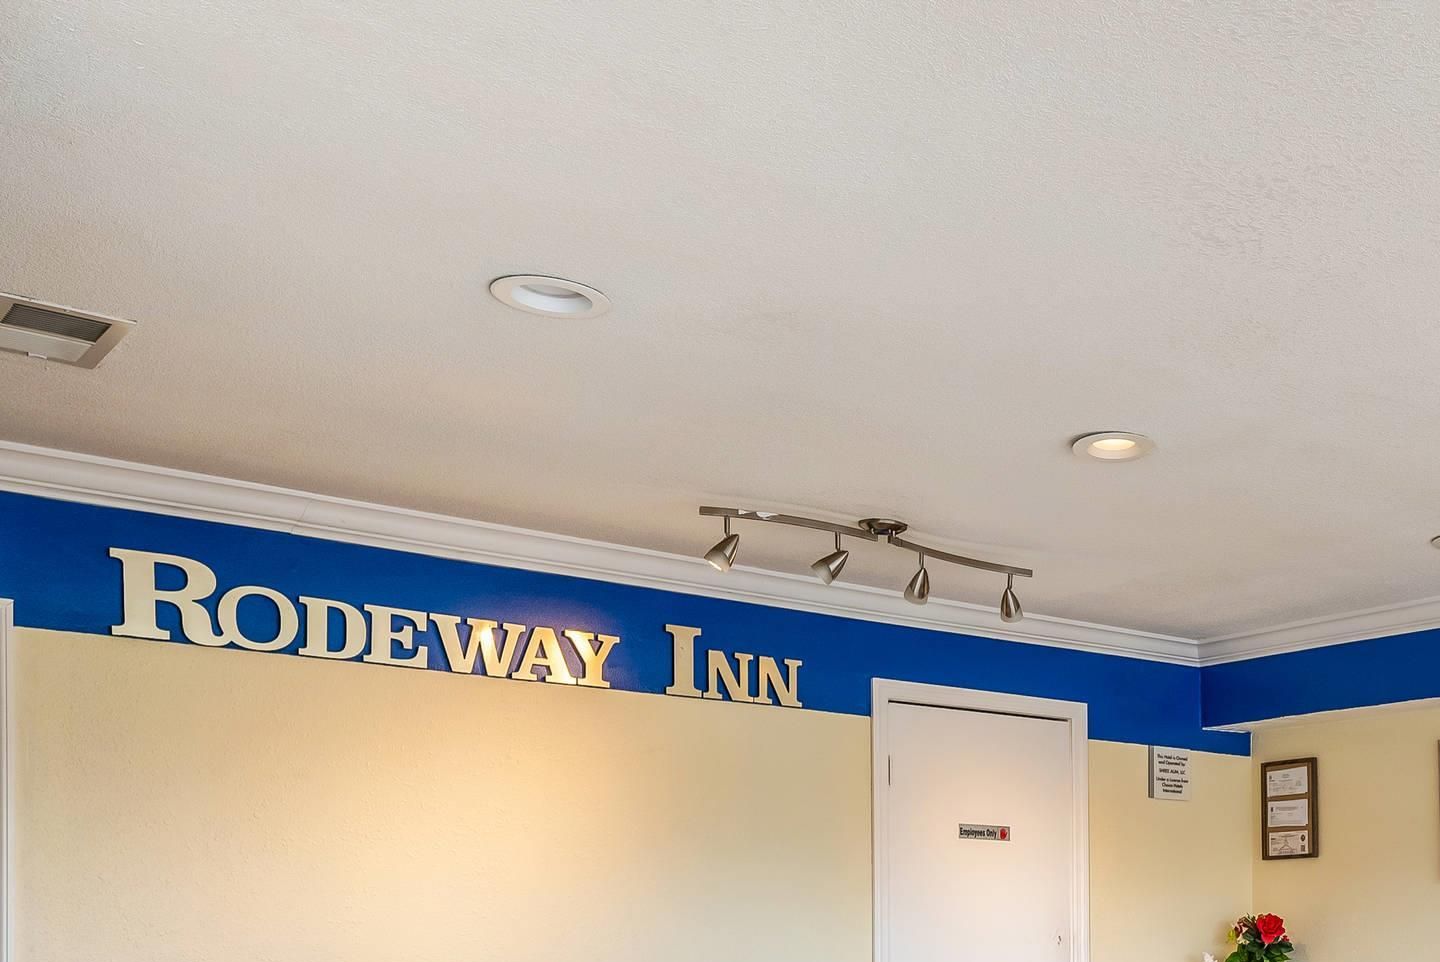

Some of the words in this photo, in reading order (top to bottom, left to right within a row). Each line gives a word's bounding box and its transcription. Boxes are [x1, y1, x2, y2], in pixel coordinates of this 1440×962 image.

[108, 546, 621, 691] RODEWAY
[665, 623, 804, 708] INN
[960, 827, 986, 838] Employees
[986, 828, 997, 840] Only
